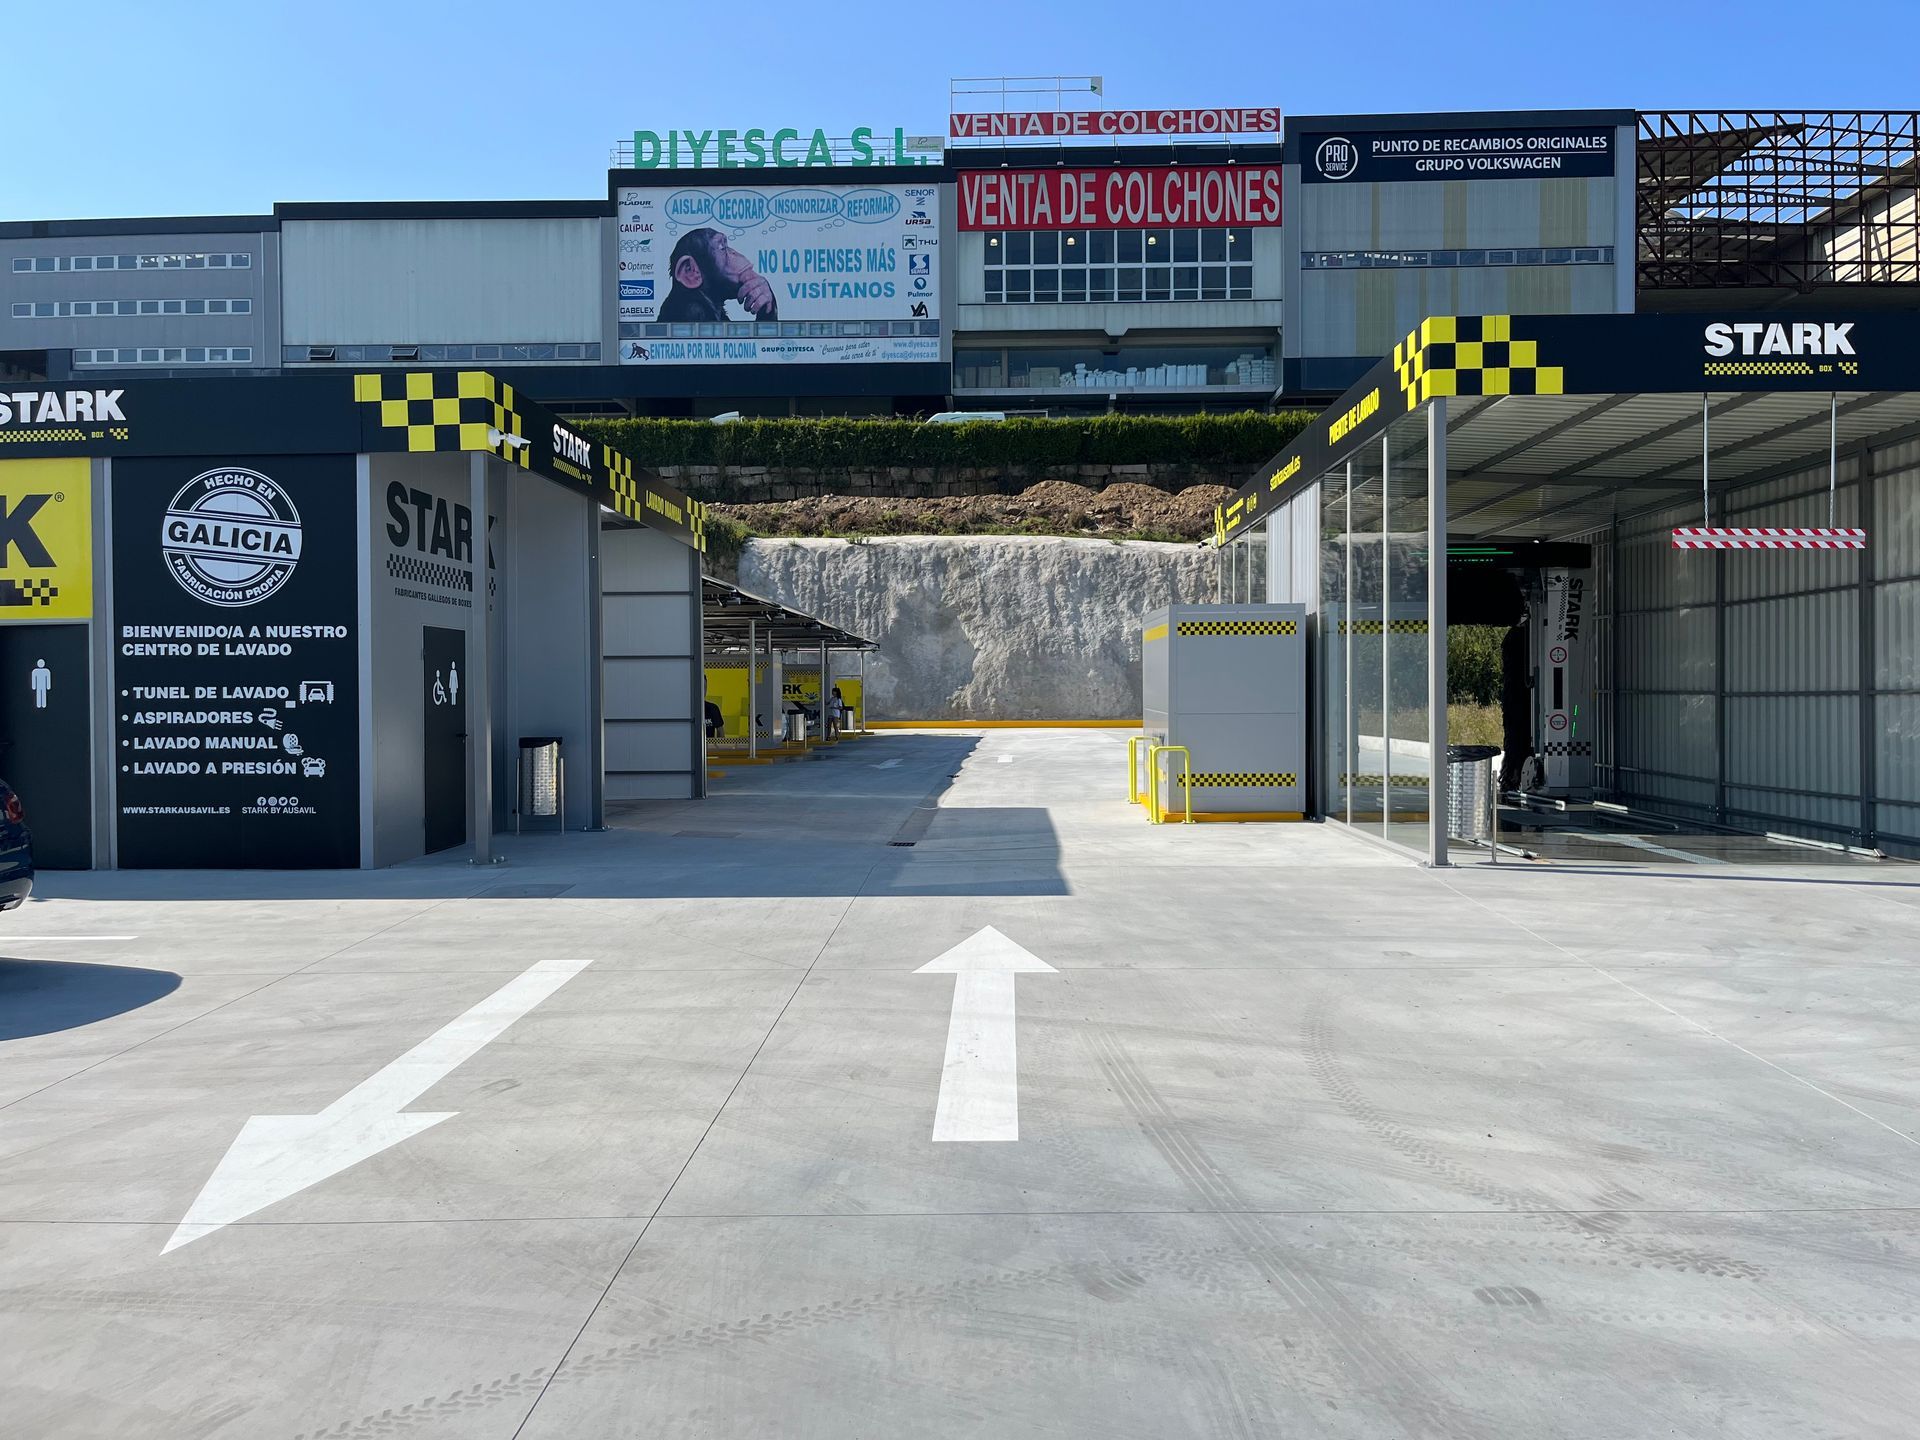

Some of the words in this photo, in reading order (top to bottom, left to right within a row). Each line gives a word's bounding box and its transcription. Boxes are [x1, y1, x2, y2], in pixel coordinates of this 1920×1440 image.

[952, 114, 1044, 136] VENTA
[1052, 112, 1090, 134] DE
[1099, 109, 1277, 134] COLCHONES
[633, 129, 834, 168] DIYESCA
[851, 127, 926, 166] S.L.
[1372, 139, 1418, 152] PUNTO
[1422, 139, 1440, 151] DE
[1444, 138, 1524, 150] RECAMBIOS
[1526, 136, 1607, 150] ORIGINALES
[1326, 145, 1348, 162] PRO
[1326, 162, 1348, 172] SERVICE
[1415, 159, 1464, 172] GRUPO
[1468, 156, 1561, 171] VOLKSWAGEN
[904, 188, 934, 196] SENOR
[962, 174, 1052, 226] VENTA
[1060, 172, 1096, 224] DE
[1105, 170, 1280, 224] COLCHONES
[672, 198, 712, 214] AISLAR
[718, 198, 764, 220] DECORAR
[774, 198, 838, 215] INSONORIZAR
[847, 196, 894, 218] REFORMAR
[758, 249, 778, 274] NO
[782, 249, 800, 274] LO
[804, 248, 862, 273] PIENSES
[866, 242, 896, 273] MÁS
[628, 262, 654, 272] Optimer
[623, 286, 648, 295] danosa
[787, 279, 896, 300] VISÍTANOS
[1704, 322, 1856, 356] STARK
[650, 344, 684, 360] ENTRADA
[687, 344, 702, 359] POR
[704, 343, 720, 358] RUA
[723, 342, 757, 358] POLONIA
[1819, 364, 1832, 372] BOX
[1348, 406, 1356, 431] DE
[1357, 387, 1380, 424] LAVADO
[552, 424, 591, 469] STARK
[204, 474, 254, 490] HECHO
[256, 482, 276, 500] EN
[168, 521, 293, 555] GALICIA
[174, 558, 242, 600] FABRICACIÓN
[246, 569, 284, 599] PROPIA
[394, 587, 427, 600] FABRICANTES
[428, 593, 450, 605] GALLEGOS
[452, 598, 457, 606] DE
[458, 599, 472, 608] BOXES
[1564, 577, 1584, 642] STARK
[122, 626, 244, 639] BIENVENIDO/A
[249, 626, 261, 637] A
[266, 626, 348, 638] NUESTRO
[122, 644, 192, 656] CENTRO
[198, 644, 219, 656] DE
[225, 644, 292, 656] LAVADO
[133, 686, 189, 699] TUNEL
[195, 686, 216, 699] DE
[222, 686, 289, 699] LAVADO
[133, 712, 253, 724] ASPIRADORES
[134, 737, 200, 749] LAVADO
[205, 737, 278, 749] MANUAL
[134, 762, 200, 774] LAVADO
[205, 762, 217, 774] A
[222, 759, 296, 774] PRESIÓN
[122, 806, 230, 814] WWW.STARKAUSAVIL.ES
[242, 806, 268, 814] STARK
[270, 806, 282, 814] BY
[283, 806, 316, 814] AUSAVIL
